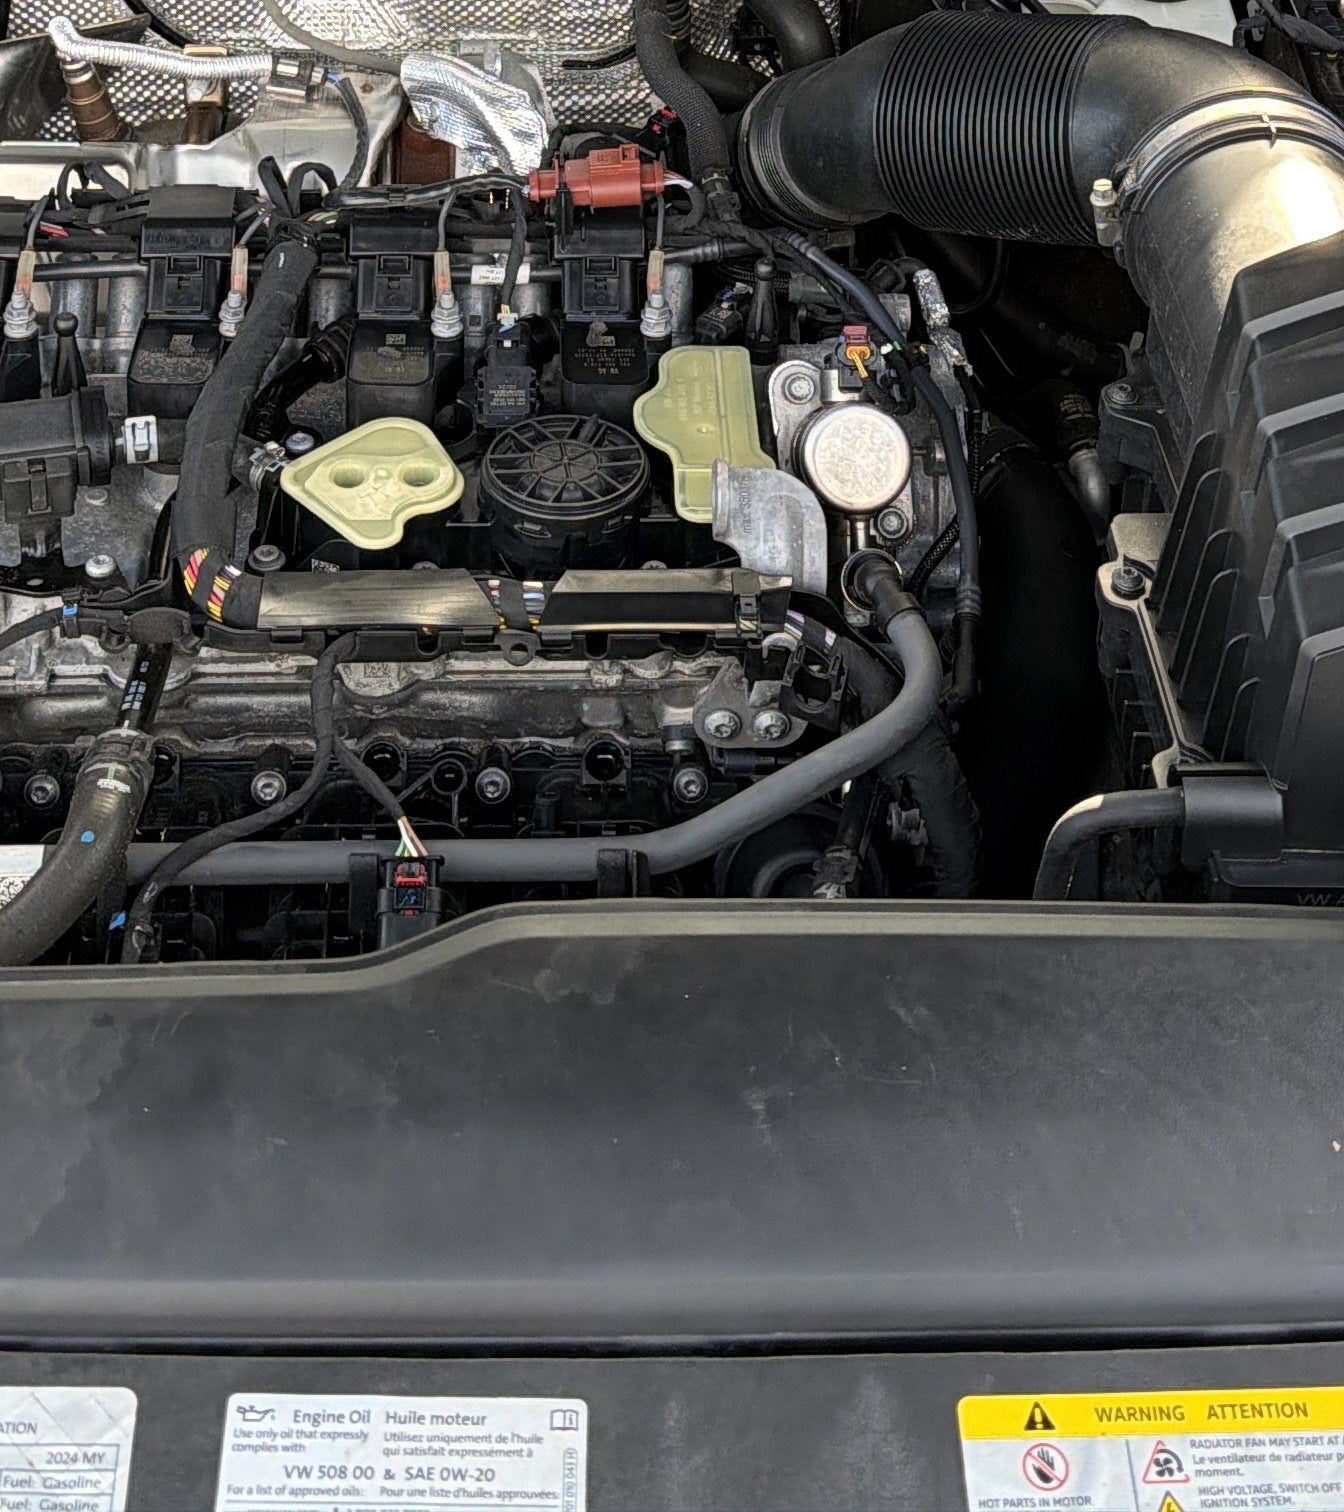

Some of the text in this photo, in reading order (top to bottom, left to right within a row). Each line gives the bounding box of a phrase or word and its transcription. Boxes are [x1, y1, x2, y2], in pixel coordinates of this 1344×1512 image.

[292, 1409, 371, 1427] Engine Oil
[385, 1411, 487, 1426] Huile moteur
[1094, 1402, 1309, 1422] WARNING ATTENTION
[233, 1428, 369, 1443] Use only oil that expressly
[384, 1432, 424, 1442] Utilisez
[426, 1433, 492, 1445] uniquement
[495, 1433, 508, 1443] de
[1190, 1438, 1242, 1449] RADIATOR
[1245, 1438, 1266, 1448] FAN
[1269, 1437, 1290, 1447] MAY
[1293, 1436, 1324, 1446] START
[1327, 1435, 1340, 1445] AT
[231, 1442, 306, 1453] complies with
[382, 1447, 400, 1457] qui
[403, 1446, 445, 1456] satisfait
[45, 1451, 106, 1464] 2024 MY
[1192, 1455, 1206, 1464] Le
[1208, 1453, 1266, 1463] ventilateur
[1269, 1453, 1282, 1462] de
[1285, 1452, 1333, 1461] radiateur
[283, 1465, 495, 1482] VW 508 00 & SAE 0W-20
[1195, 1468, 1244, 1477] moment.
[42, 1475, 102, 1489] Gasoline
[226, 1484, 244, 1495] For
[256, 1485, 272, 1495] list
[274, 1485, 286, 1495] of
[288, 1486, 340, 1497] approved
[380, 1486, 404, 1497] Pour
[407, 1489, 427, 1497] une
[429, 1487, 451, 1498] liste
[1198, 1486, 1224, 1496] HIGH
[1280, 1483, 1318, 1493] SWITCH
[1321, 1483, 1341, 1493] OFF
[39, 1498, 100, 1512] Gasoline
[978, 1496, 1091, 1509] HOT PARTS IN MOTOR
[1200, 1497, 1248, 1508] IGNITION
